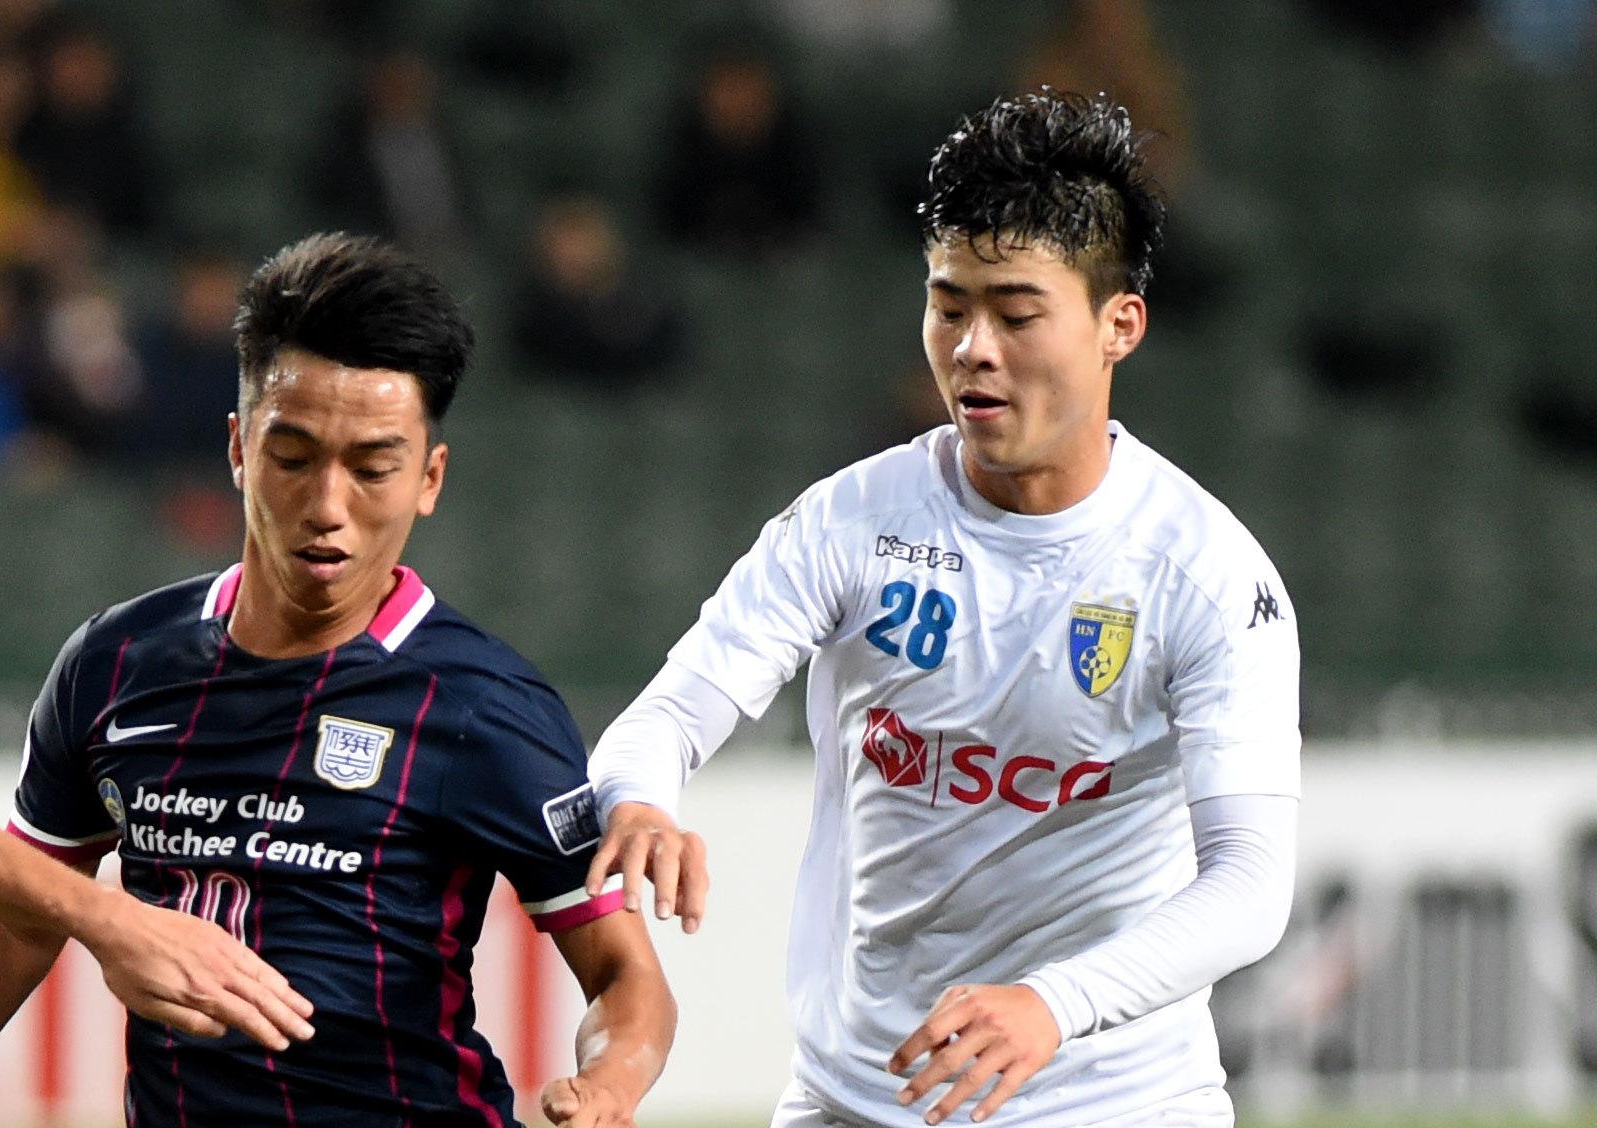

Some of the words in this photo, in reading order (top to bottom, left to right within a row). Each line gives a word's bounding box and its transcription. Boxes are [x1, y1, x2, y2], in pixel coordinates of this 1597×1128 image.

[876, 535, 964, 572] Kappa
[865, 580, 957, 670] 28
[130, 786, 228, 823] Jockey
[236, 795, 305, 823] Club
[130, 823, 238, 857] Kitchee
[246, 831, 363, 873] Centre
